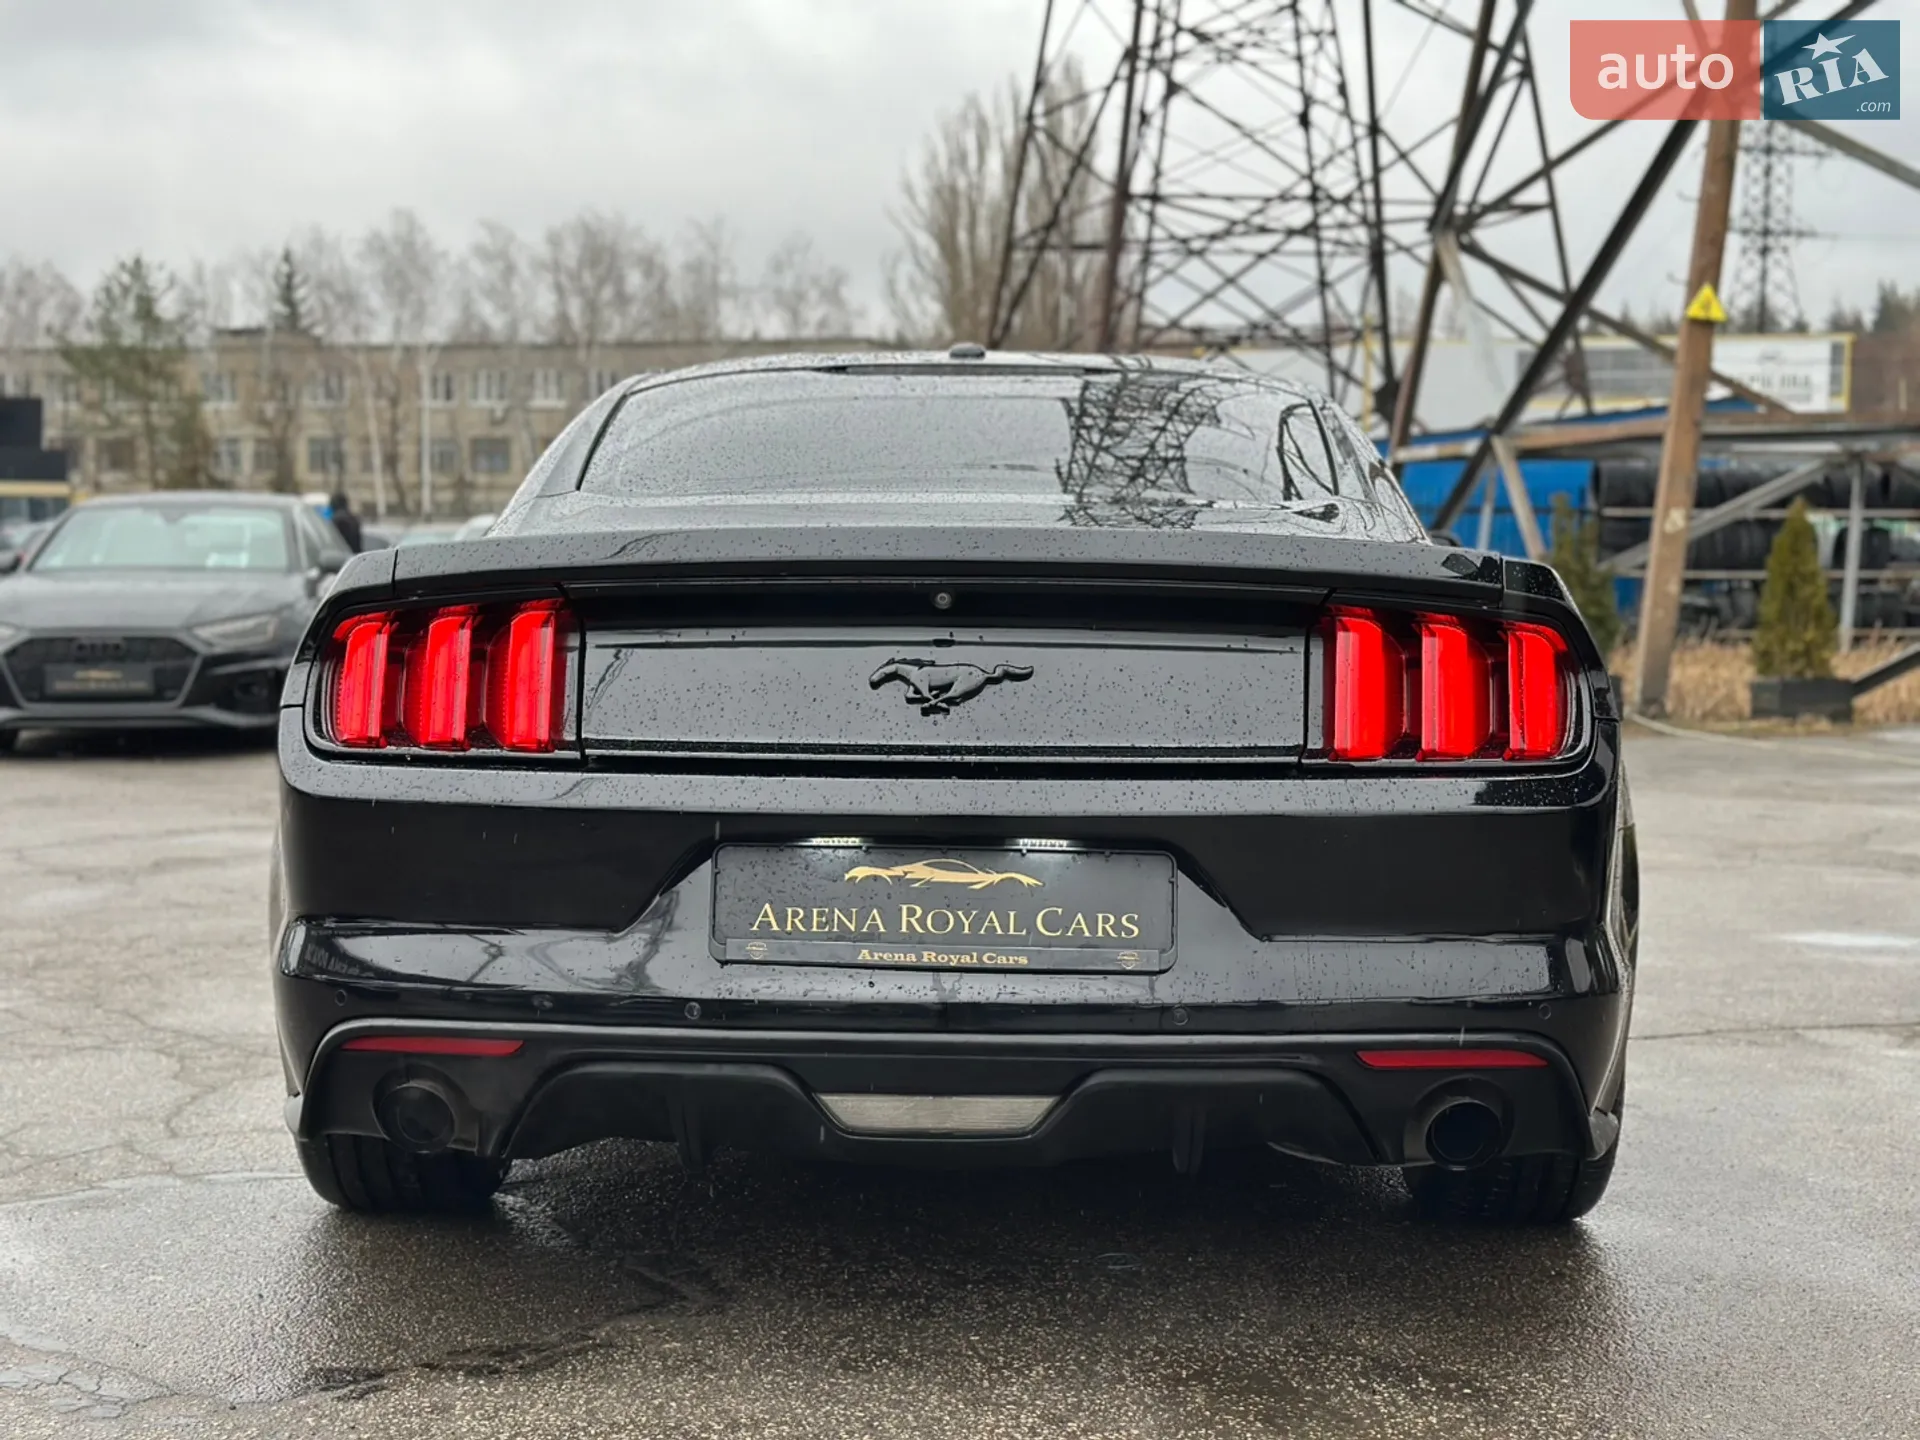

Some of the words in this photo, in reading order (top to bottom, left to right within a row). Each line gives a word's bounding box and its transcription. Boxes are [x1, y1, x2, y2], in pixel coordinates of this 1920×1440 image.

[750, 902, 887, 933] ARENA
[899, 903, 1027, 935] ROYAL
[1035, 906, 1140, 939] CARS
[857, 949, 917, 963] Arena
[921, 951, 978, 966] Royal
[982, 952, 1029, 966] Cars
